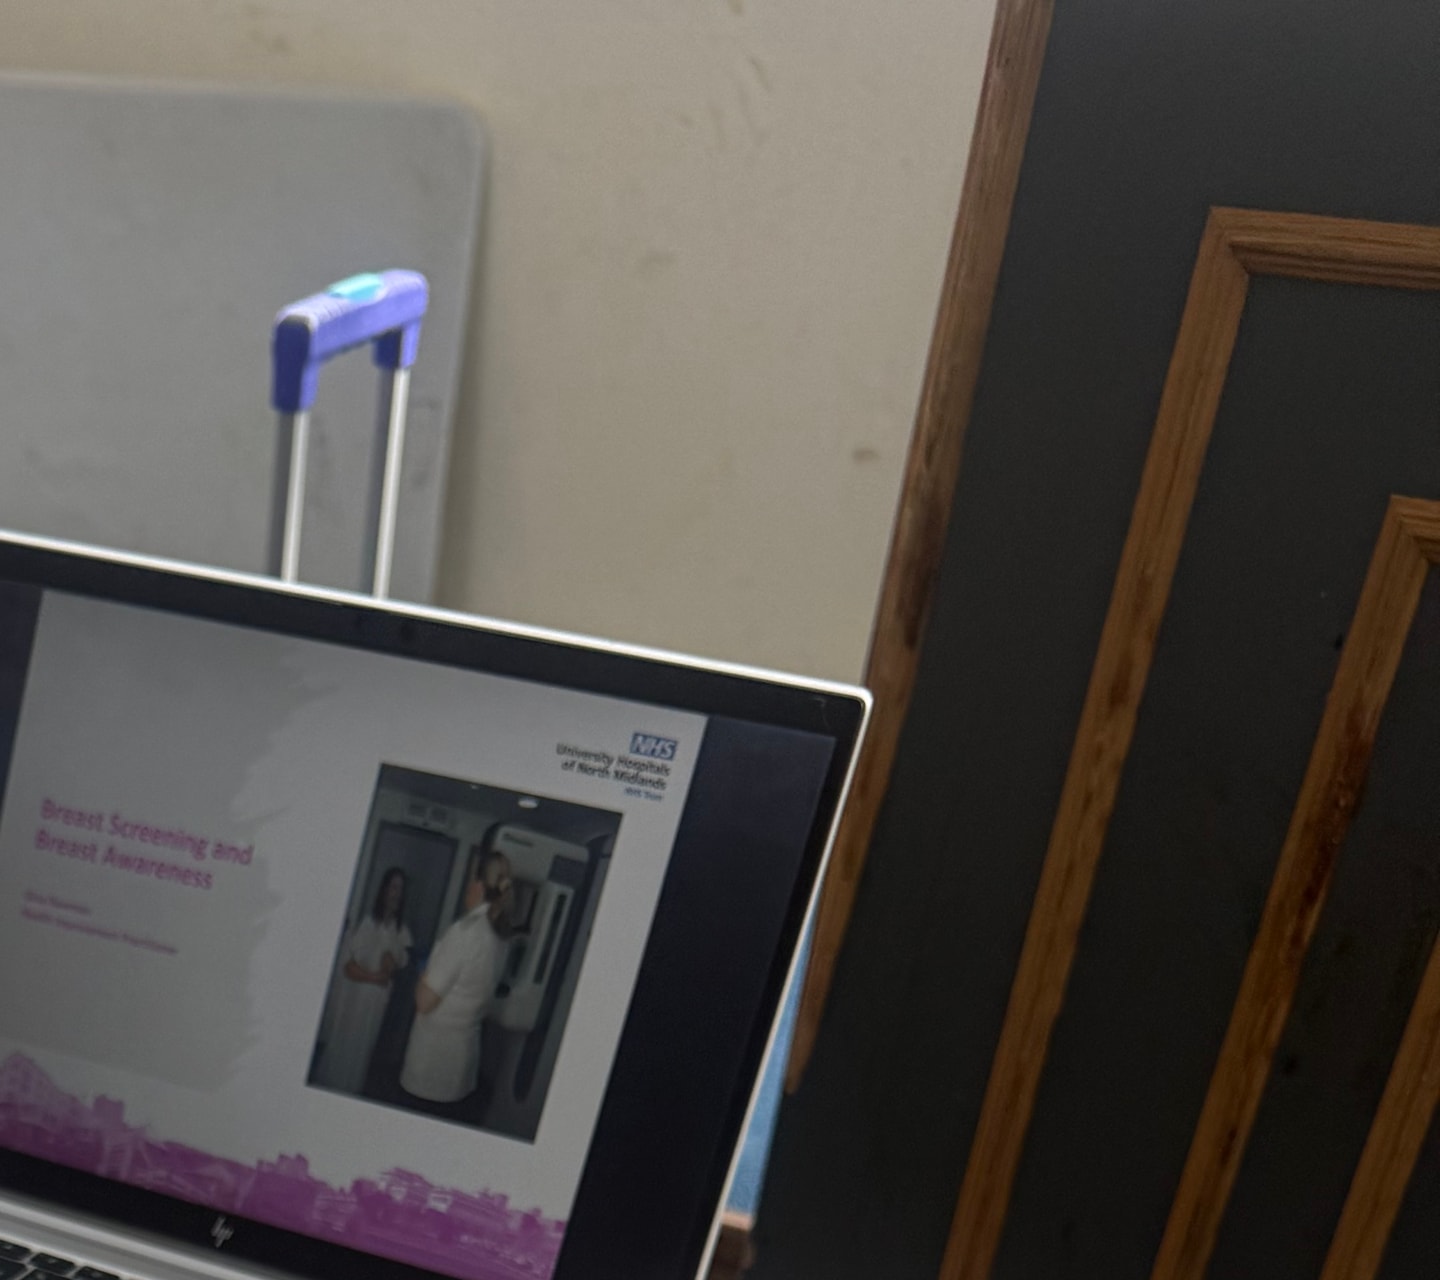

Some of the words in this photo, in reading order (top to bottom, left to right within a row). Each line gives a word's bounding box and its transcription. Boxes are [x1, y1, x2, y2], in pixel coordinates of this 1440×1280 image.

[556, 743, 613, 767] University
[617, 755, 671, 777] Hospitals
[633, 734, 676, 760] NHS
[562, 760, 576, 771] of
[577, 762, 609, 778] North
[613, 770, 667, 791] Midlands
[42, 798, 104, 832] Breast
[108, 812, 209, 861] Screening
[212, 842, 255, 866] and
[35, 828, 98, 864] Breast
[102, 846, 213, 889] Awareness
